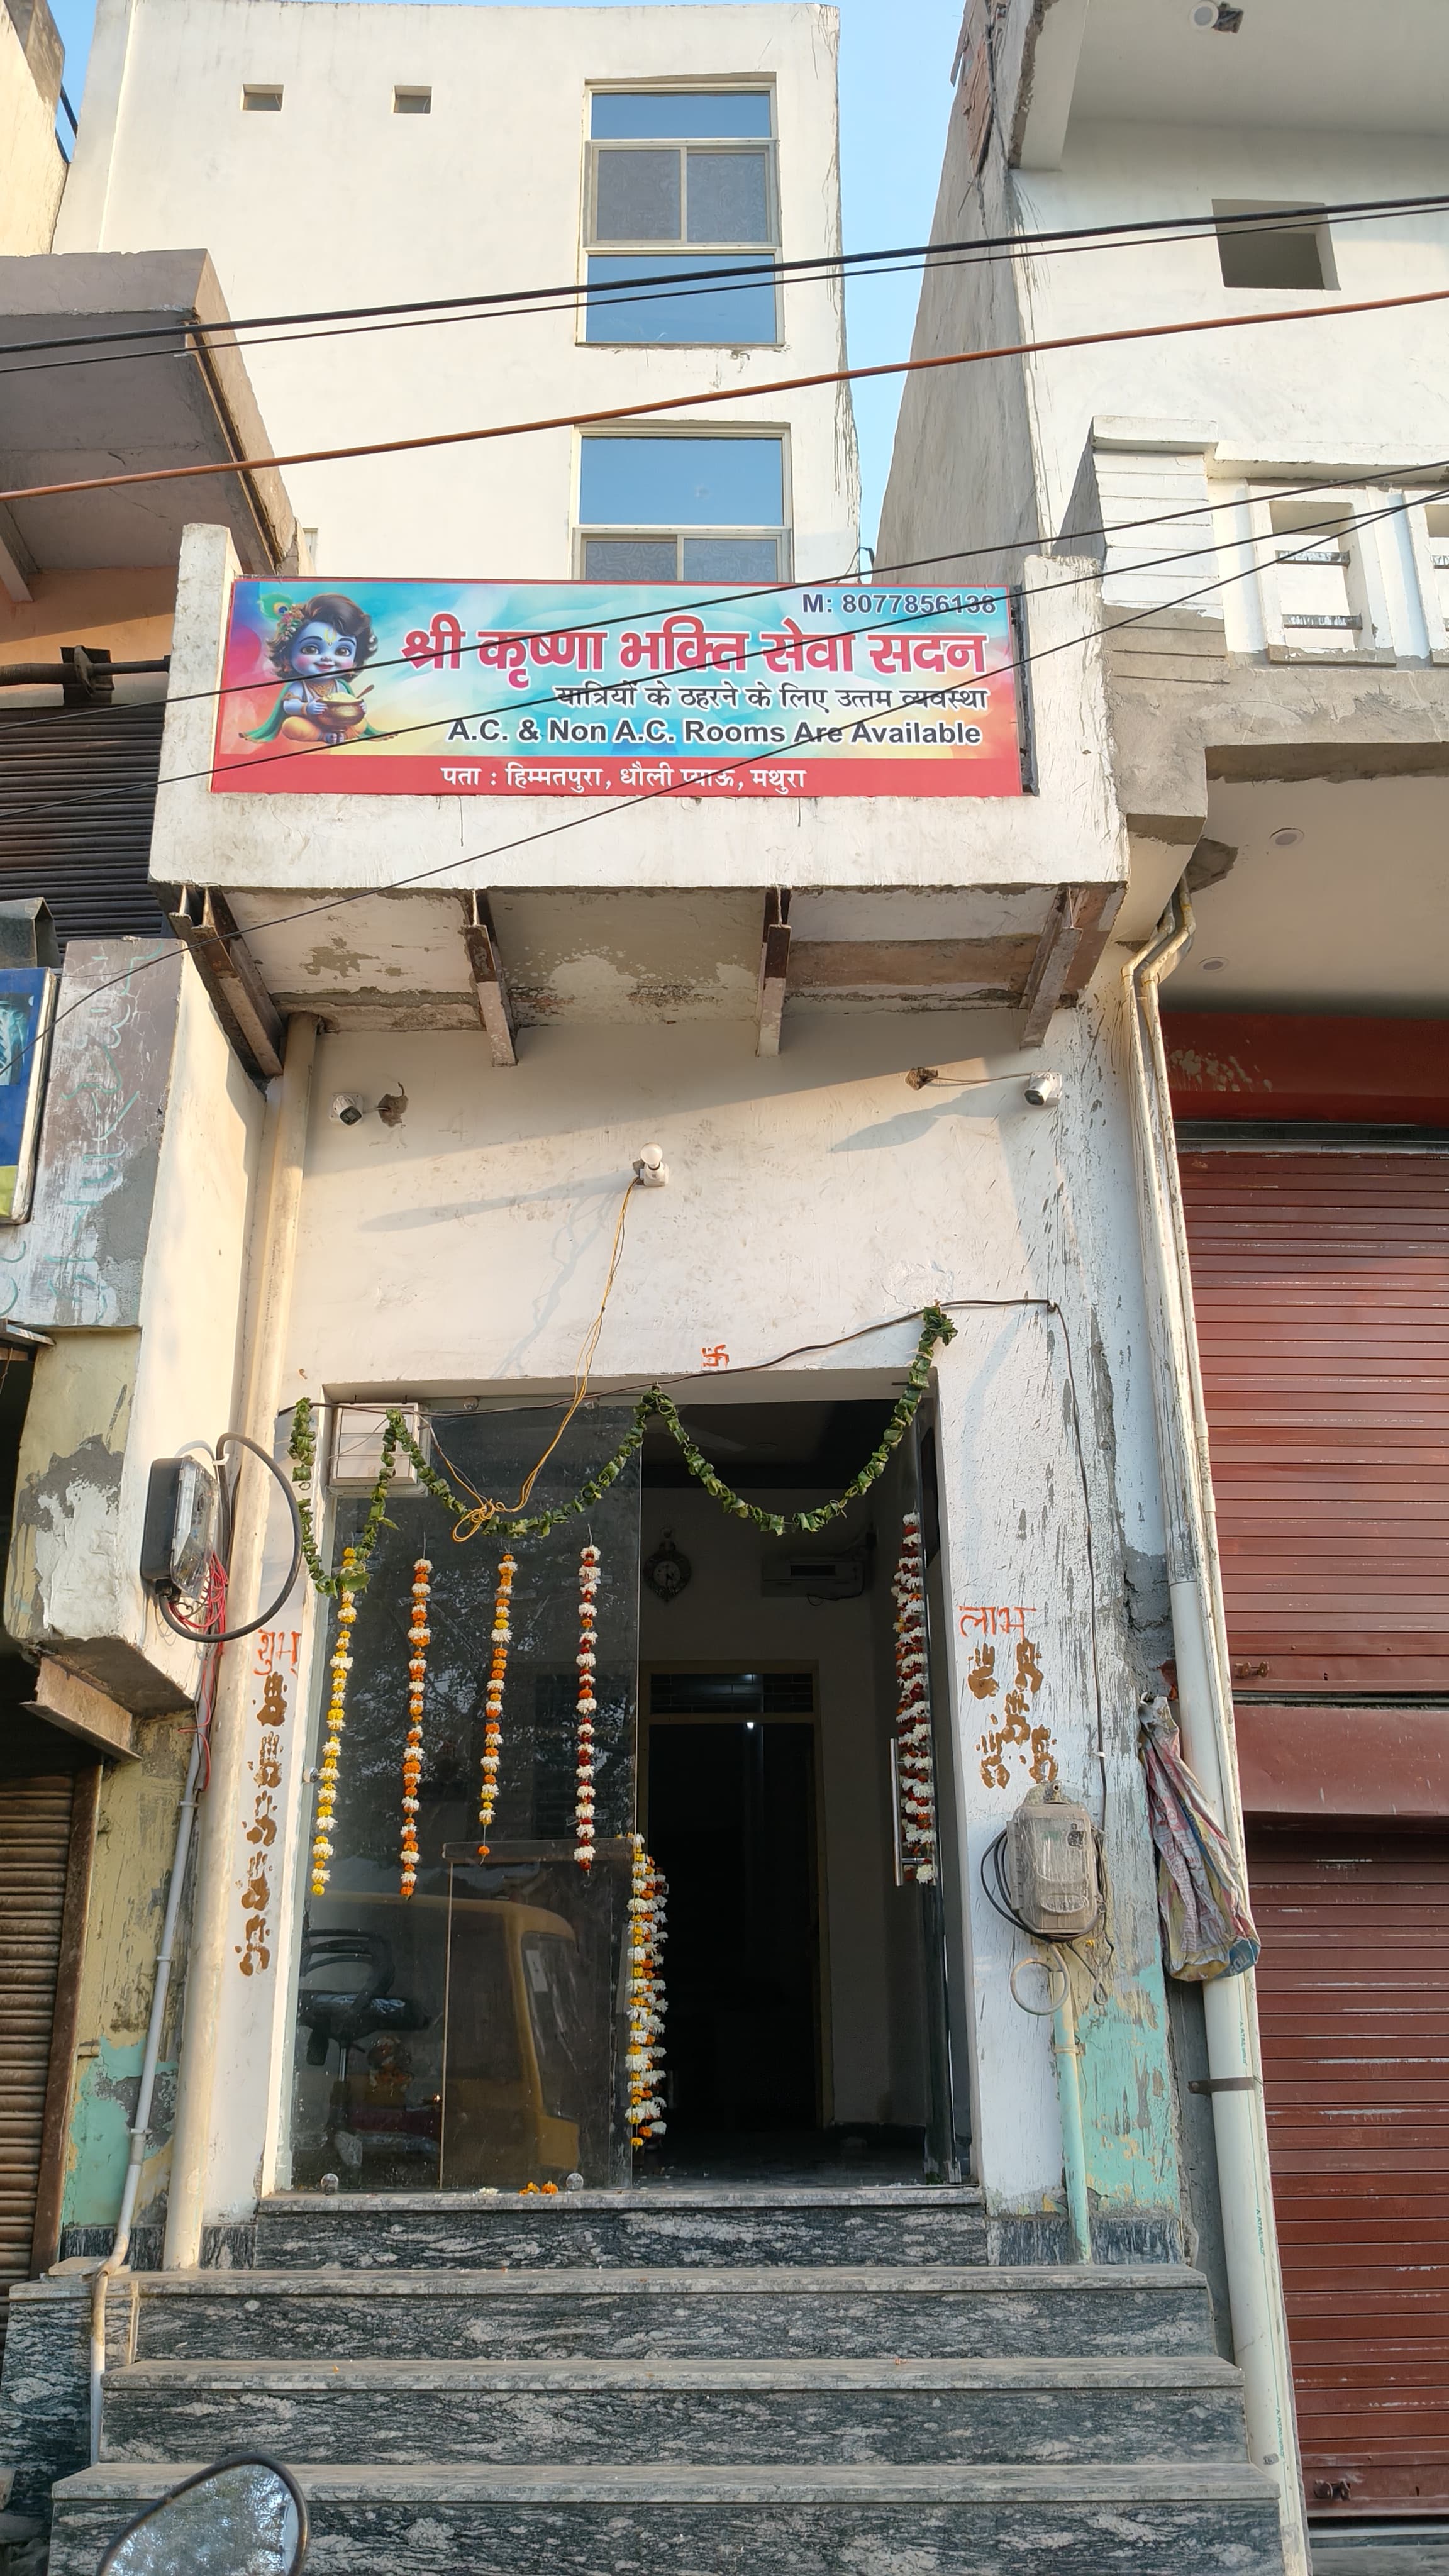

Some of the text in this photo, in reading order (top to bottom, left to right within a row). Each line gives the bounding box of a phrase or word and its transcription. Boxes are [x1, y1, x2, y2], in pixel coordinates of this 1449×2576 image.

[803, 594, 996, 614] M: 8077856138
[402, 613, 987, 688] श्री कृष्णा भक्ति सेवा सदन
[554, 679, 987, 713] यात्रियों के ठहरने के लिए उत्तम व्यवस्था
[448, 719, 980, 744] A.C. & Non A.C. Rooms Are Available
[441, 767, 482, 786] पता
[505, 762, 611, 792] हिम्मतपुरा,
[620, 762, 674, 786] धौली
[750, 769, 808, 795] मथुरा
